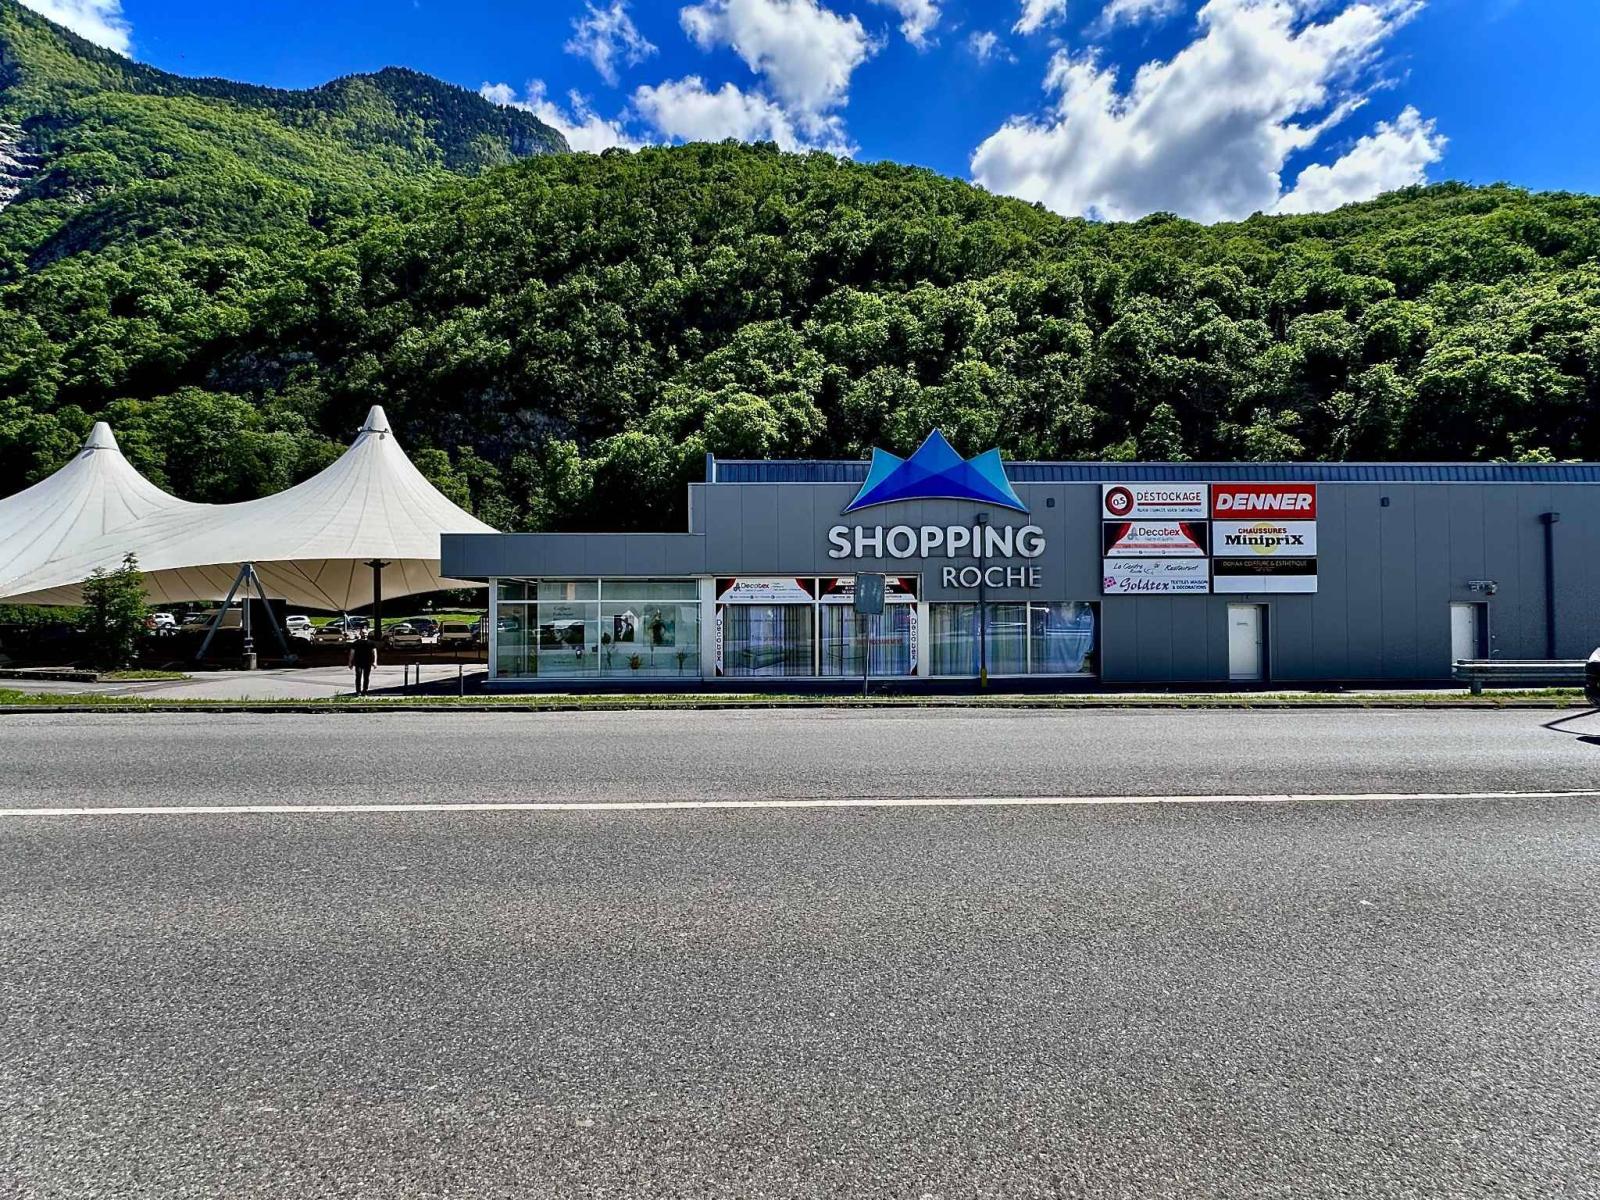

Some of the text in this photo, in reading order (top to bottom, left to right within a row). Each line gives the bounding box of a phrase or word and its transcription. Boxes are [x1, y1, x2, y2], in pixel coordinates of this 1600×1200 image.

[1216, 493, 1313, 510] DENNER
[828, 525, 1046, 558] SHOPPING
[1225, 535, 1304, 547] MinipriX
[942, 566, 1042, 588] ROCHE
[1120, 577, 1169, 592] Goldtex
